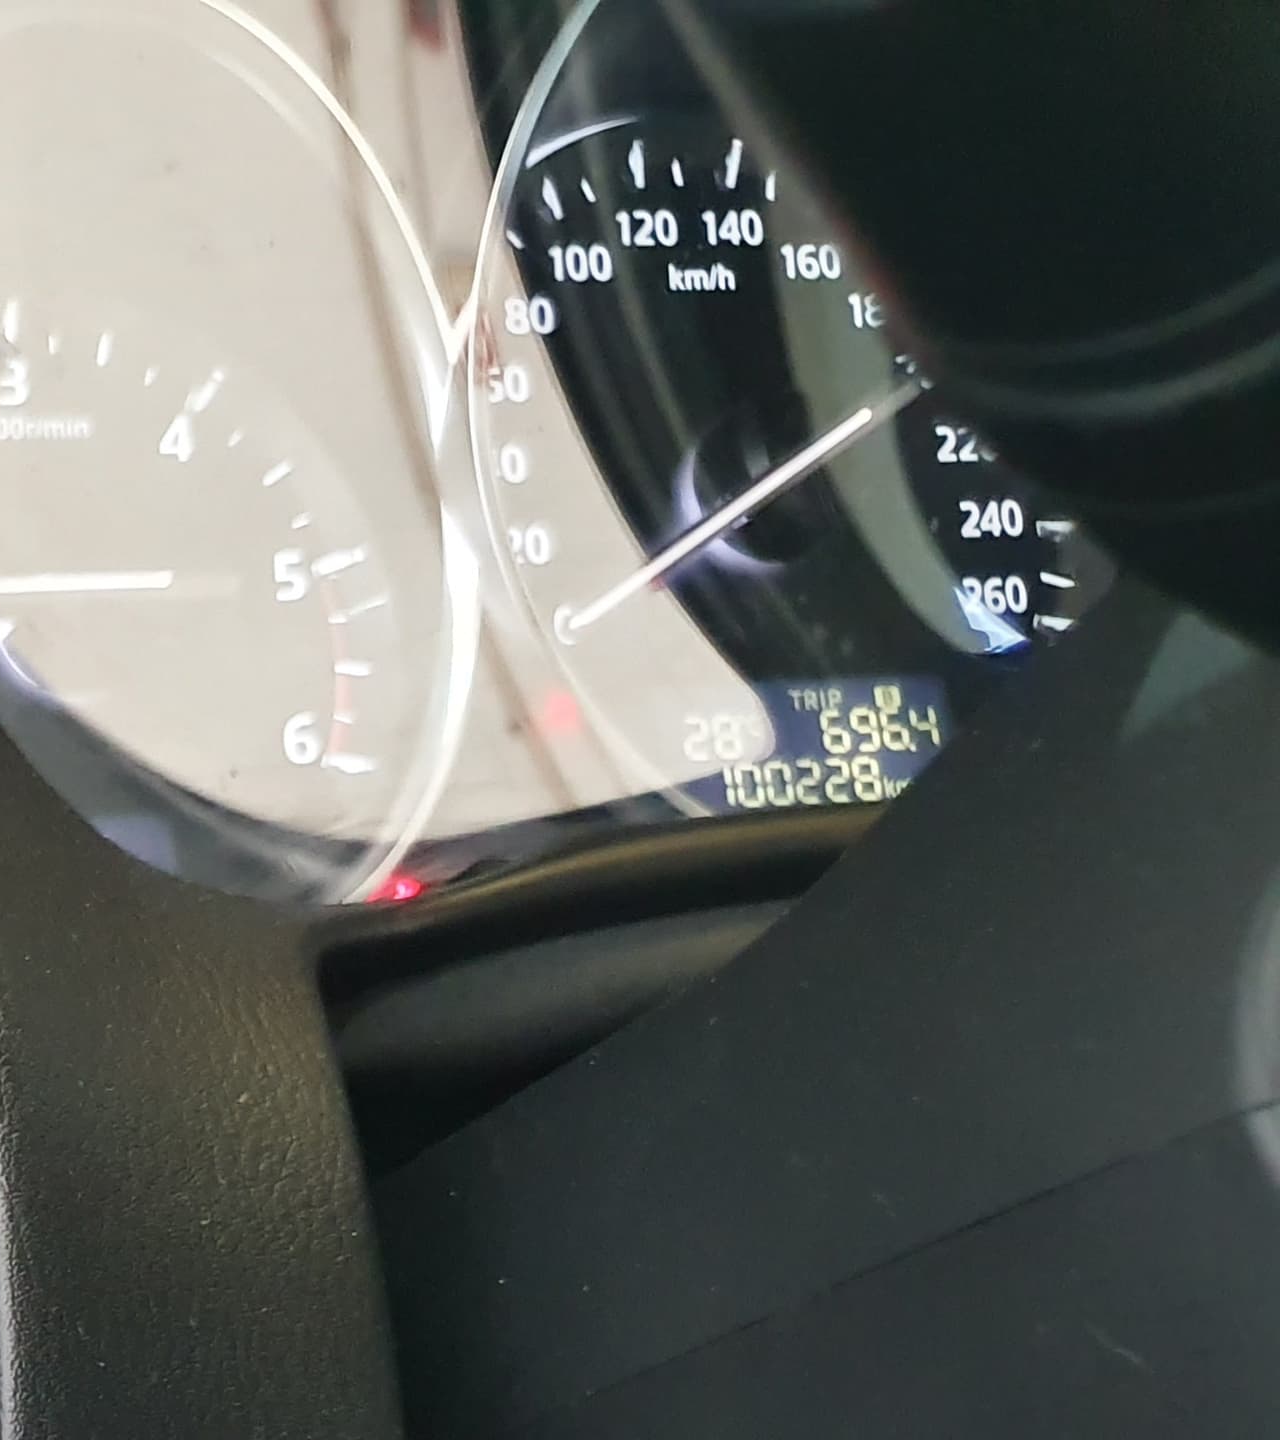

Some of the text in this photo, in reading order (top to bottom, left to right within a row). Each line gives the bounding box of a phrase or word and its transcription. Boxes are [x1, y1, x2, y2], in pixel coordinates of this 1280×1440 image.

[617, 209, 764, 247] 120 140
[549, 245, 613, 284] 100
[668, 263, 736, 293] km/h
[781, 244, 841, 280] 160
[504, 296, 557, 335] 80
[847, 293, 887, 328] 18
[159, 413, 195, 462] 4
[935, 424, 998, 462] 22
[959, 499, 1024, 538] 240
[272, 550, 306, 602] 5
[788, 687, 842, 712] TRIP
[282, 713, 319, 766] 6
[819, 704, 940, 755] 696.4
[722, 755, 882, 809] 100228
